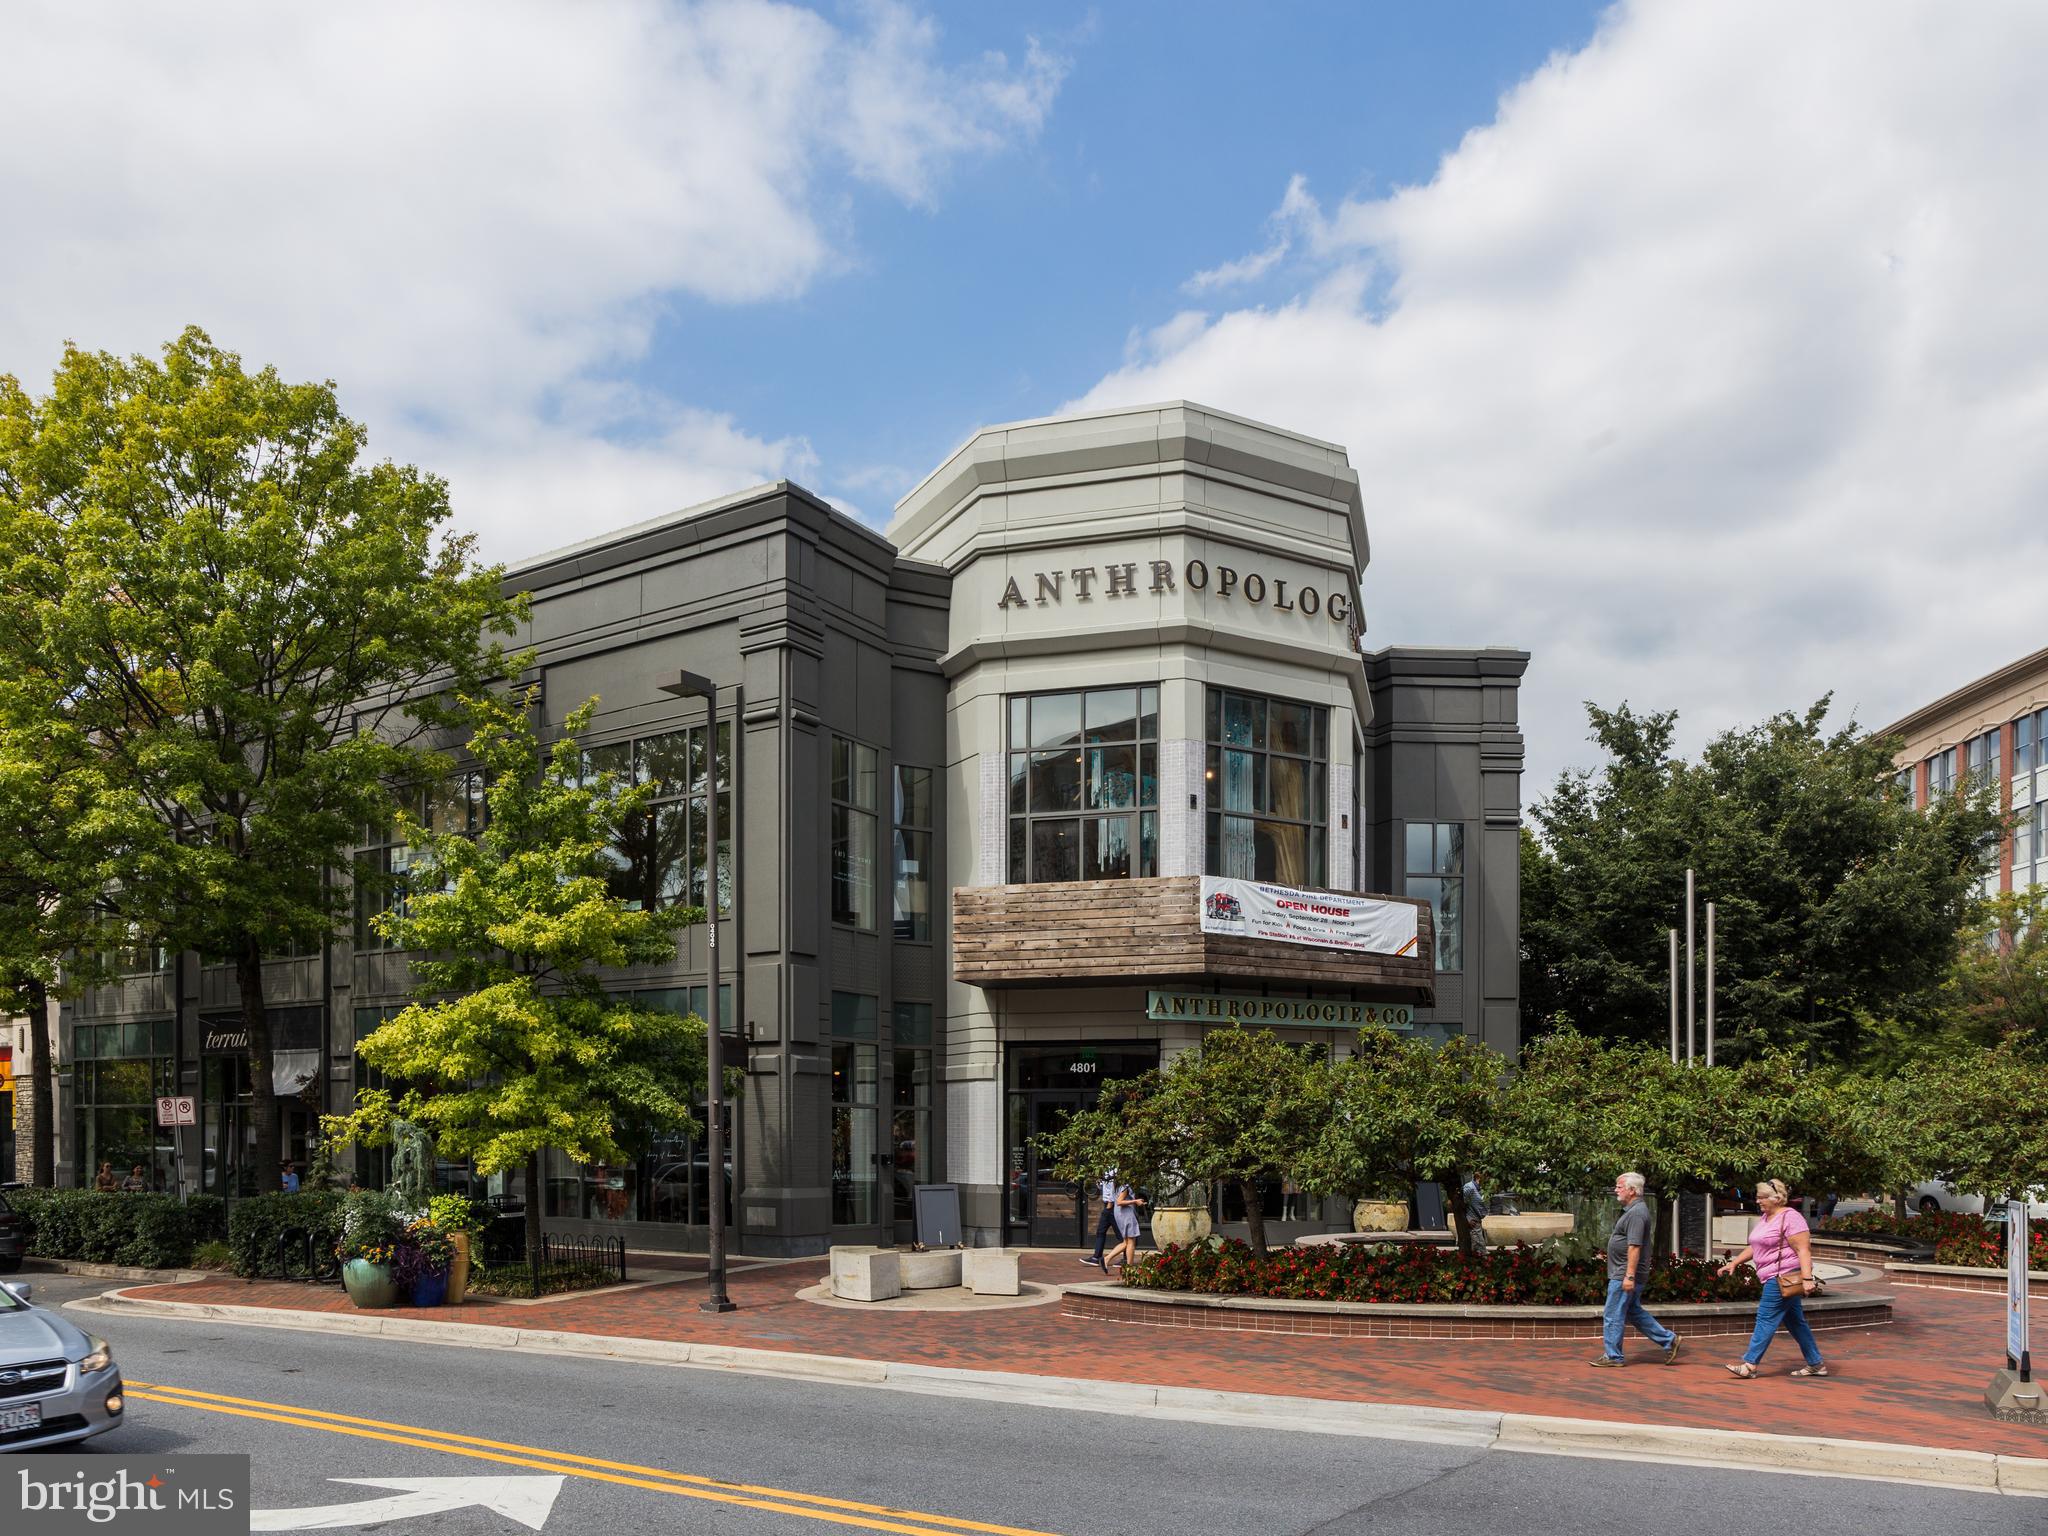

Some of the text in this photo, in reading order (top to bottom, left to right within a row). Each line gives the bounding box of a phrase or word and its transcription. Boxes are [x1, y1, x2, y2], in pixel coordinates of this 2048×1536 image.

[1259, 886, 1300, 898] BETHESDA
[1319, 895, 1366, 906] DEPARTMENT
[1276, 899, 1350, 917] OPEN HOUSE
[1289, 913, 1319, 923] September
[1292, 924, 1307, 932] Food
[1257, 929, 1269, 937] Fire
[1269, 931, 1288, 940] Station
[1302, 935, 1329, 945] Wisconsin
[1334, 938, 1354, 948] Bradley
[1070, 1062, 1096, 1073] 4801
